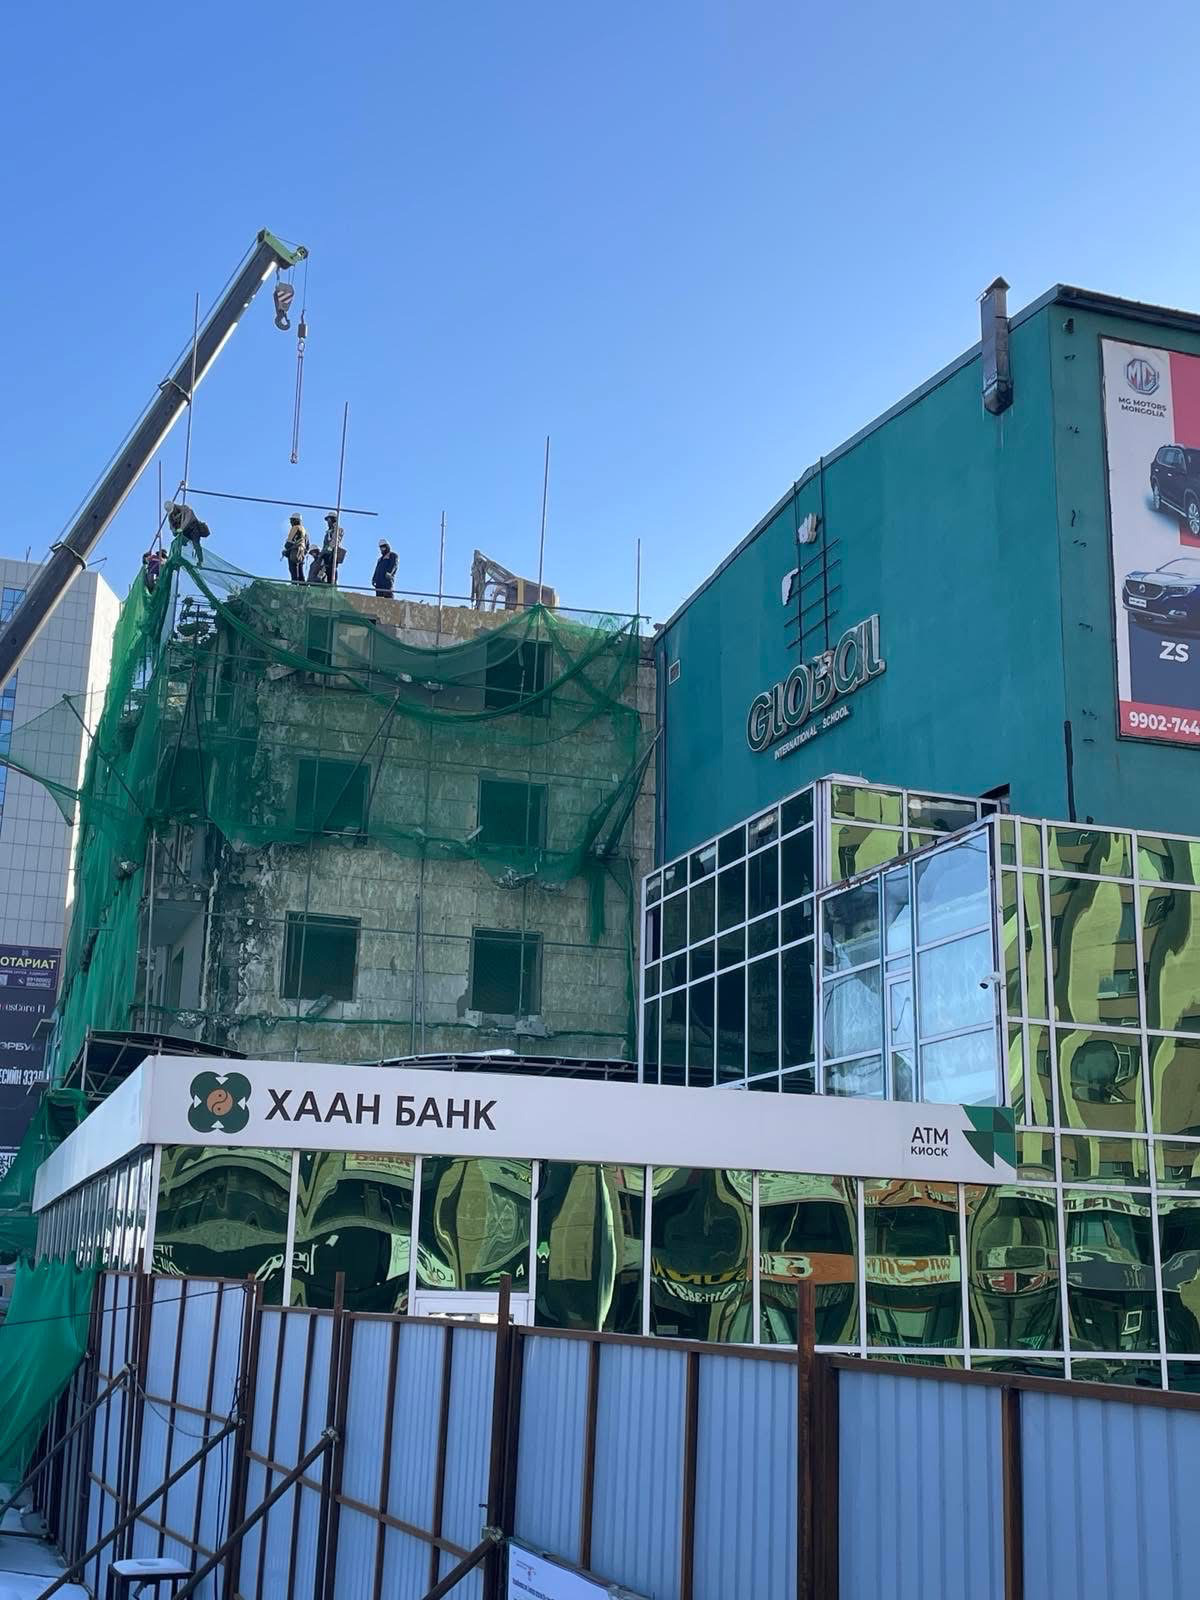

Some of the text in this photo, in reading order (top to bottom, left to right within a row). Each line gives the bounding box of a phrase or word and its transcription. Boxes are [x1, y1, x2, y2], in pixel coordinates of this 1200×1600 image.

[1118, 397, 1167, 412] MG MOTORS
[1121, 405, 1165, 418] MONGOLIA
[1159, 641, 1190, 663] ZS
[774, 705, 850, 761] INTERNATIONAL SCHOOL
[264, 1088, 498, 1131] ХААН БАНК
[911, 1126, 949, 1145] АТМ
[910, 1146, 949, 1157] КИОСК
